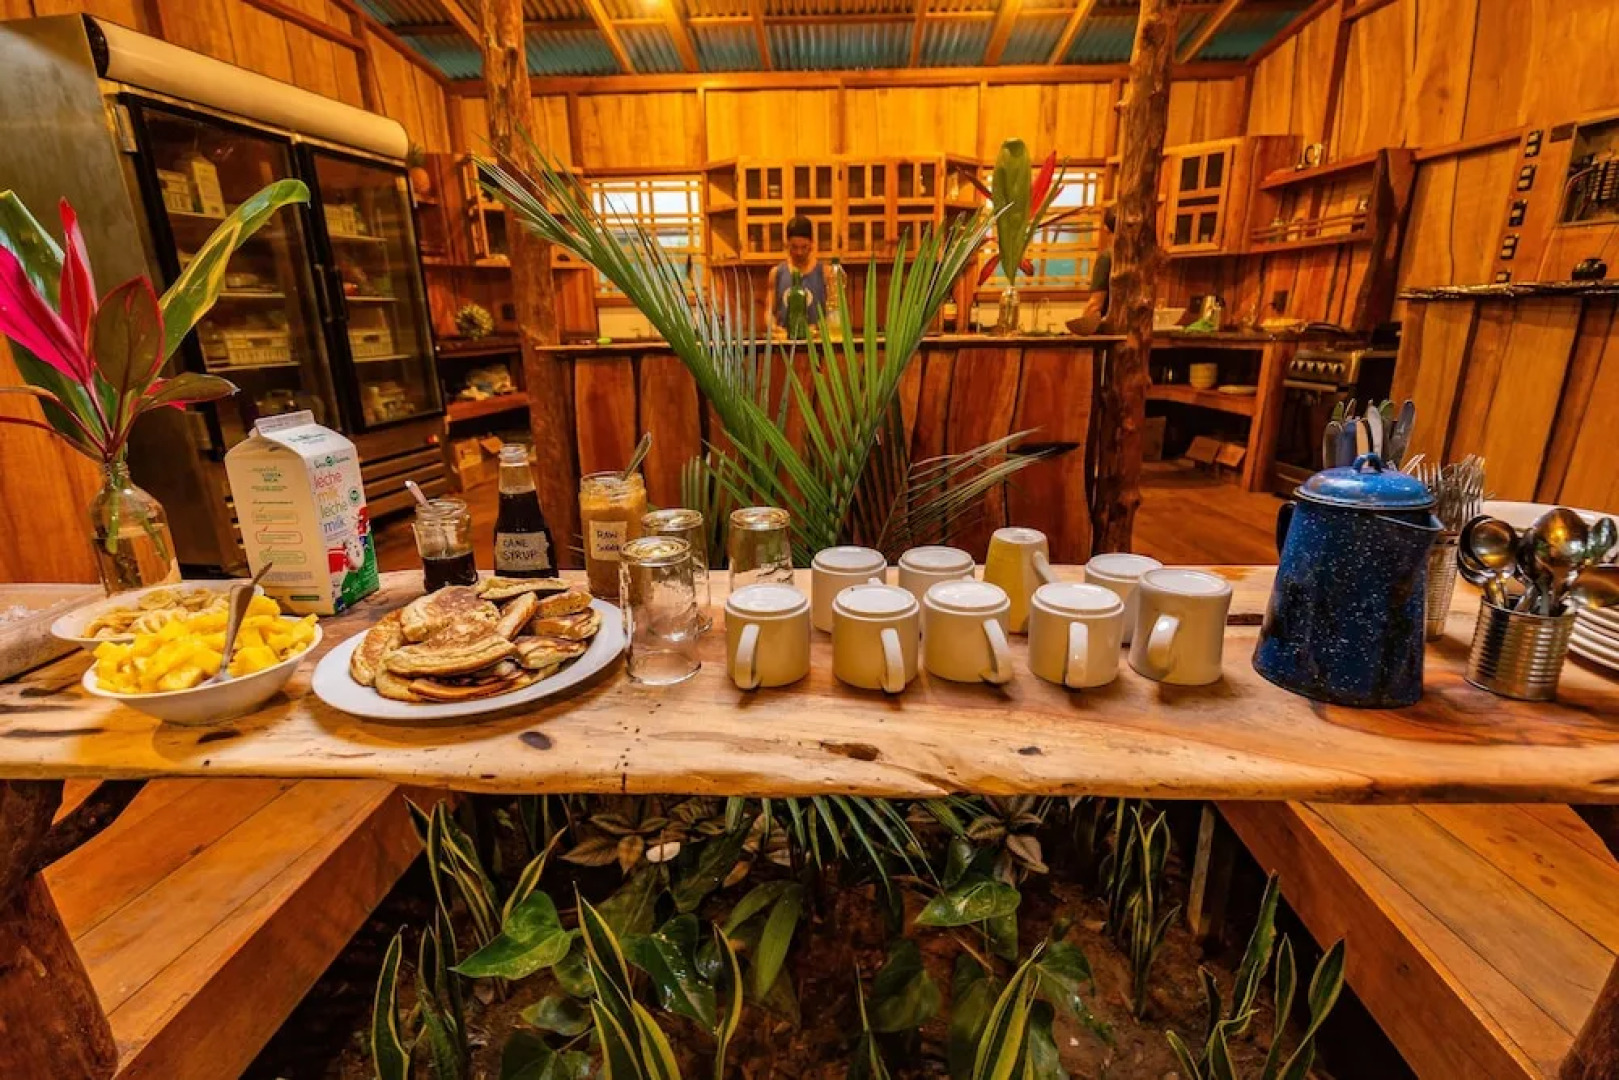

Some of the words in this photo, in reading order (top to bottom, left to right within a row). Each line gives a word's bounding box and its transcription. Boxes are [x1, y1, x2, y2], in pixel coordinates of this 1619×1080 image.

[314, 471, 342, 488] leche
[320, 502, 348, 518] leche
[324, 516, 346, 533] milk
[503, 550, 537, 561] SYRUP
